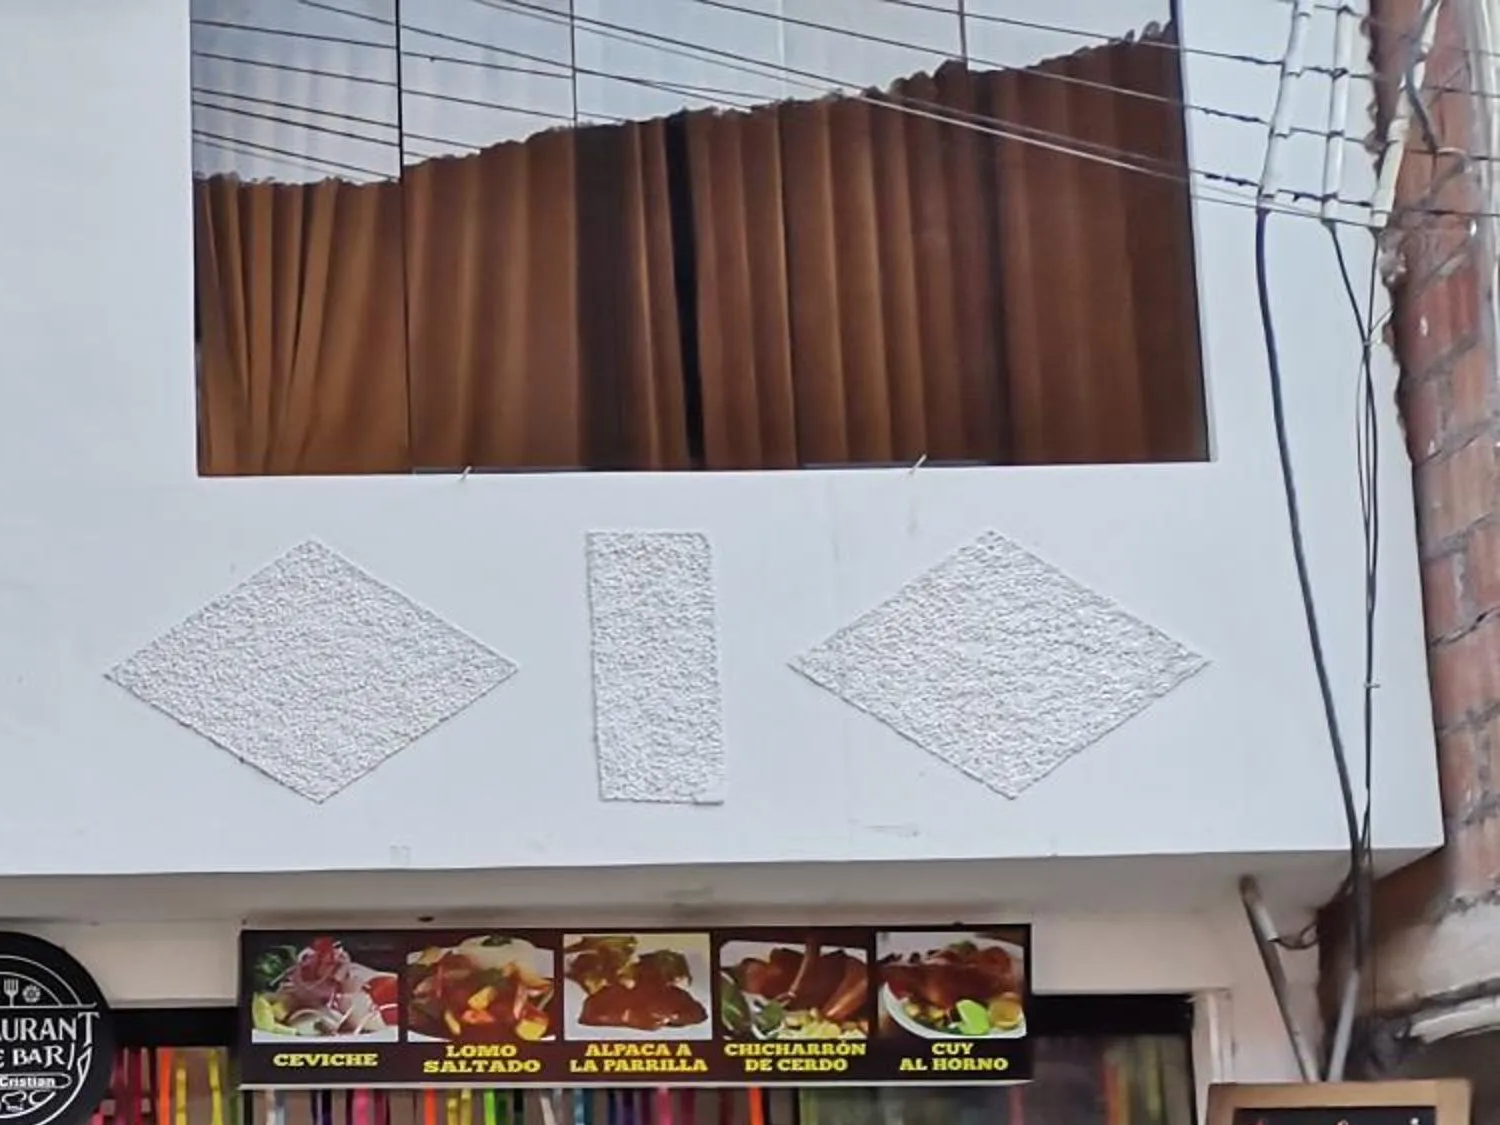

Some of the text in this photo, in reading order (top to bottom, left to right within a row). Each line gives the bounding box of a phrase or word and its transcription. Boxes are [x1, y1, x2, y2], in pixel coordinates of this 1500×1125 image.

[445, 1044, 518, 1058] LOMO
[584, 1043, 693, 1057] ALPACA A
[723, 1040, 867, 1056] CHICHARRÓN
[931, 1042, 975, 1055] CUY
[12, 1045, 66, 1069] BAR
[272, 1053, 379, 1067] CEVICHE
[899, 1057, 1009, 1071] AL HORNO
[423, 1059, 541, 1073] SALTADO
[569, 1058, 709, 1073] LA PARRILLA
[744, 1057, 849, 1072] DE CERDO
